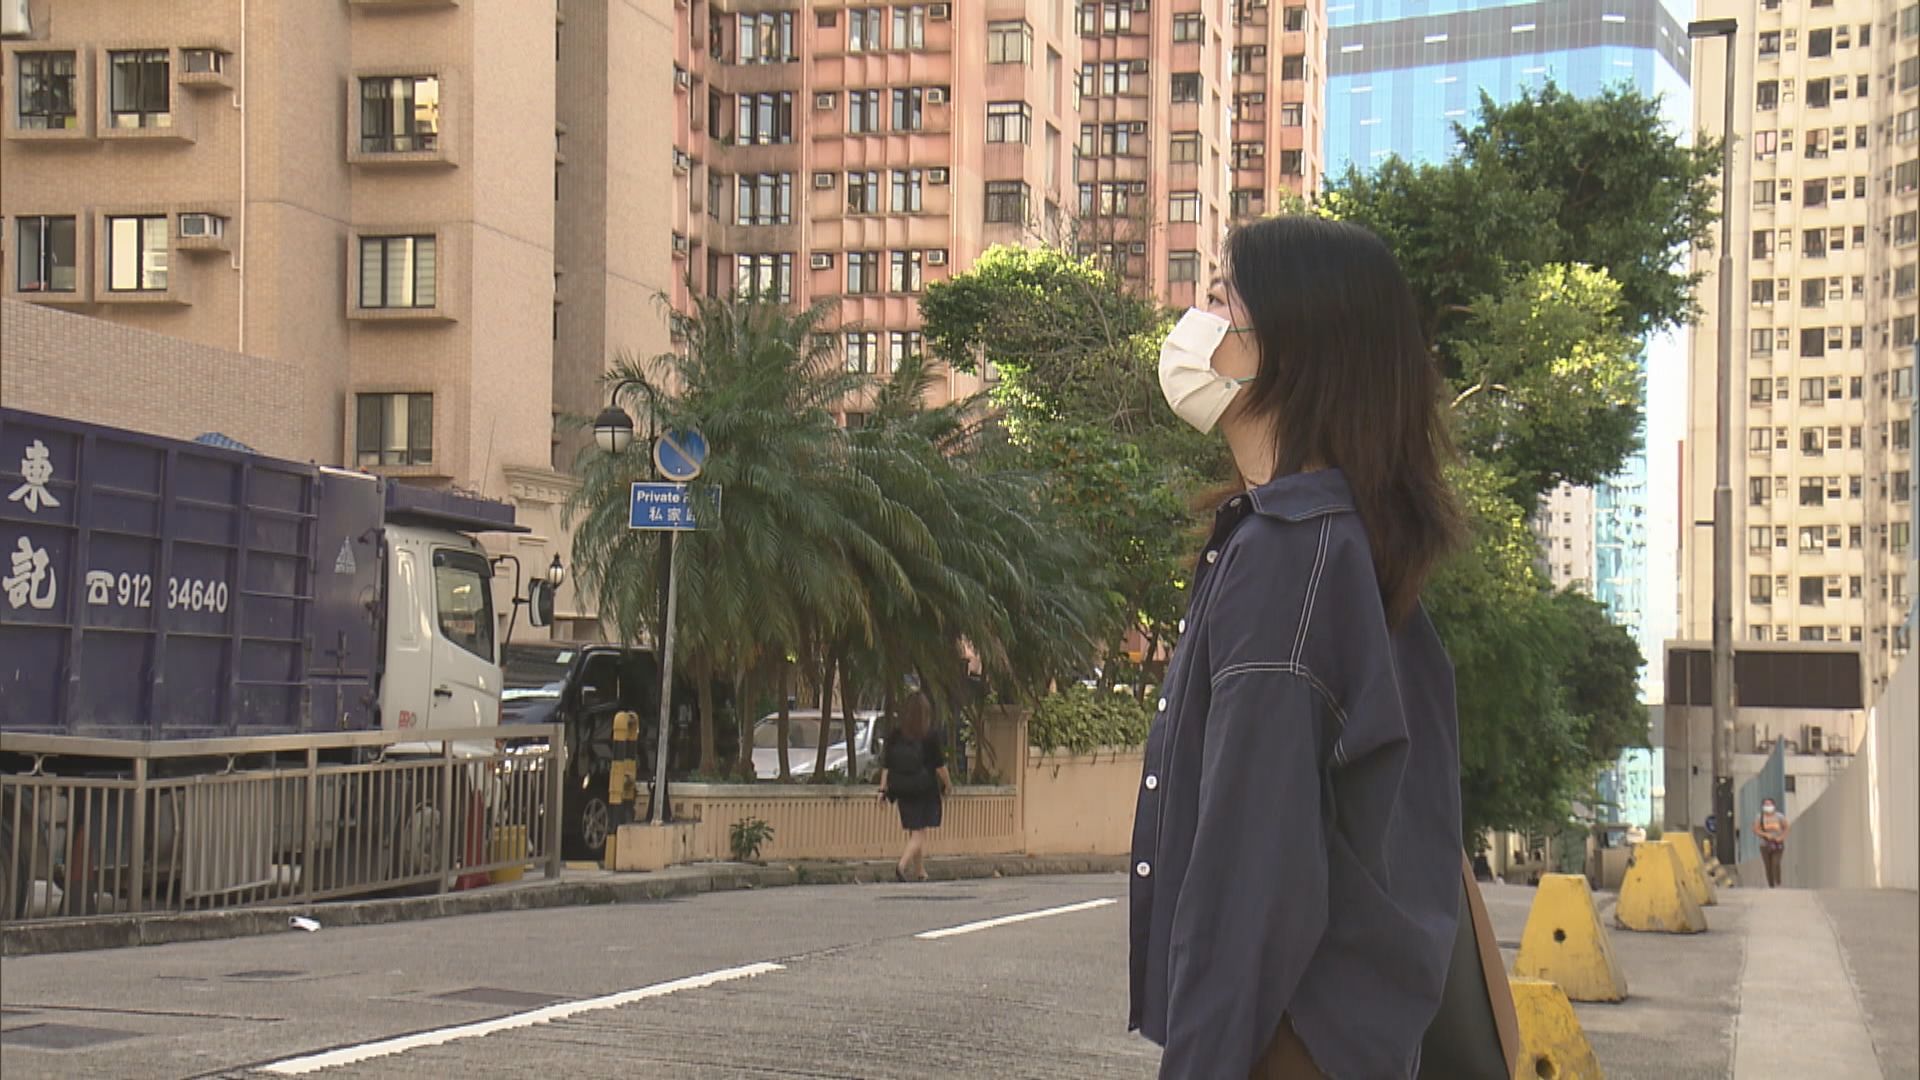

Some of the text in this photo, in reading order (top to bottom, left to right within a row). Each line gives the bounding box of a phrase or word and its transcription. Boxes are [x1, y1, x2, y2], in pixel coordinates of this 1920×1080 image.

[637, 490, 680, 503] Private
[3, 439, 60, 609] 東記
[117, 572, 228, 613] 912 34640
